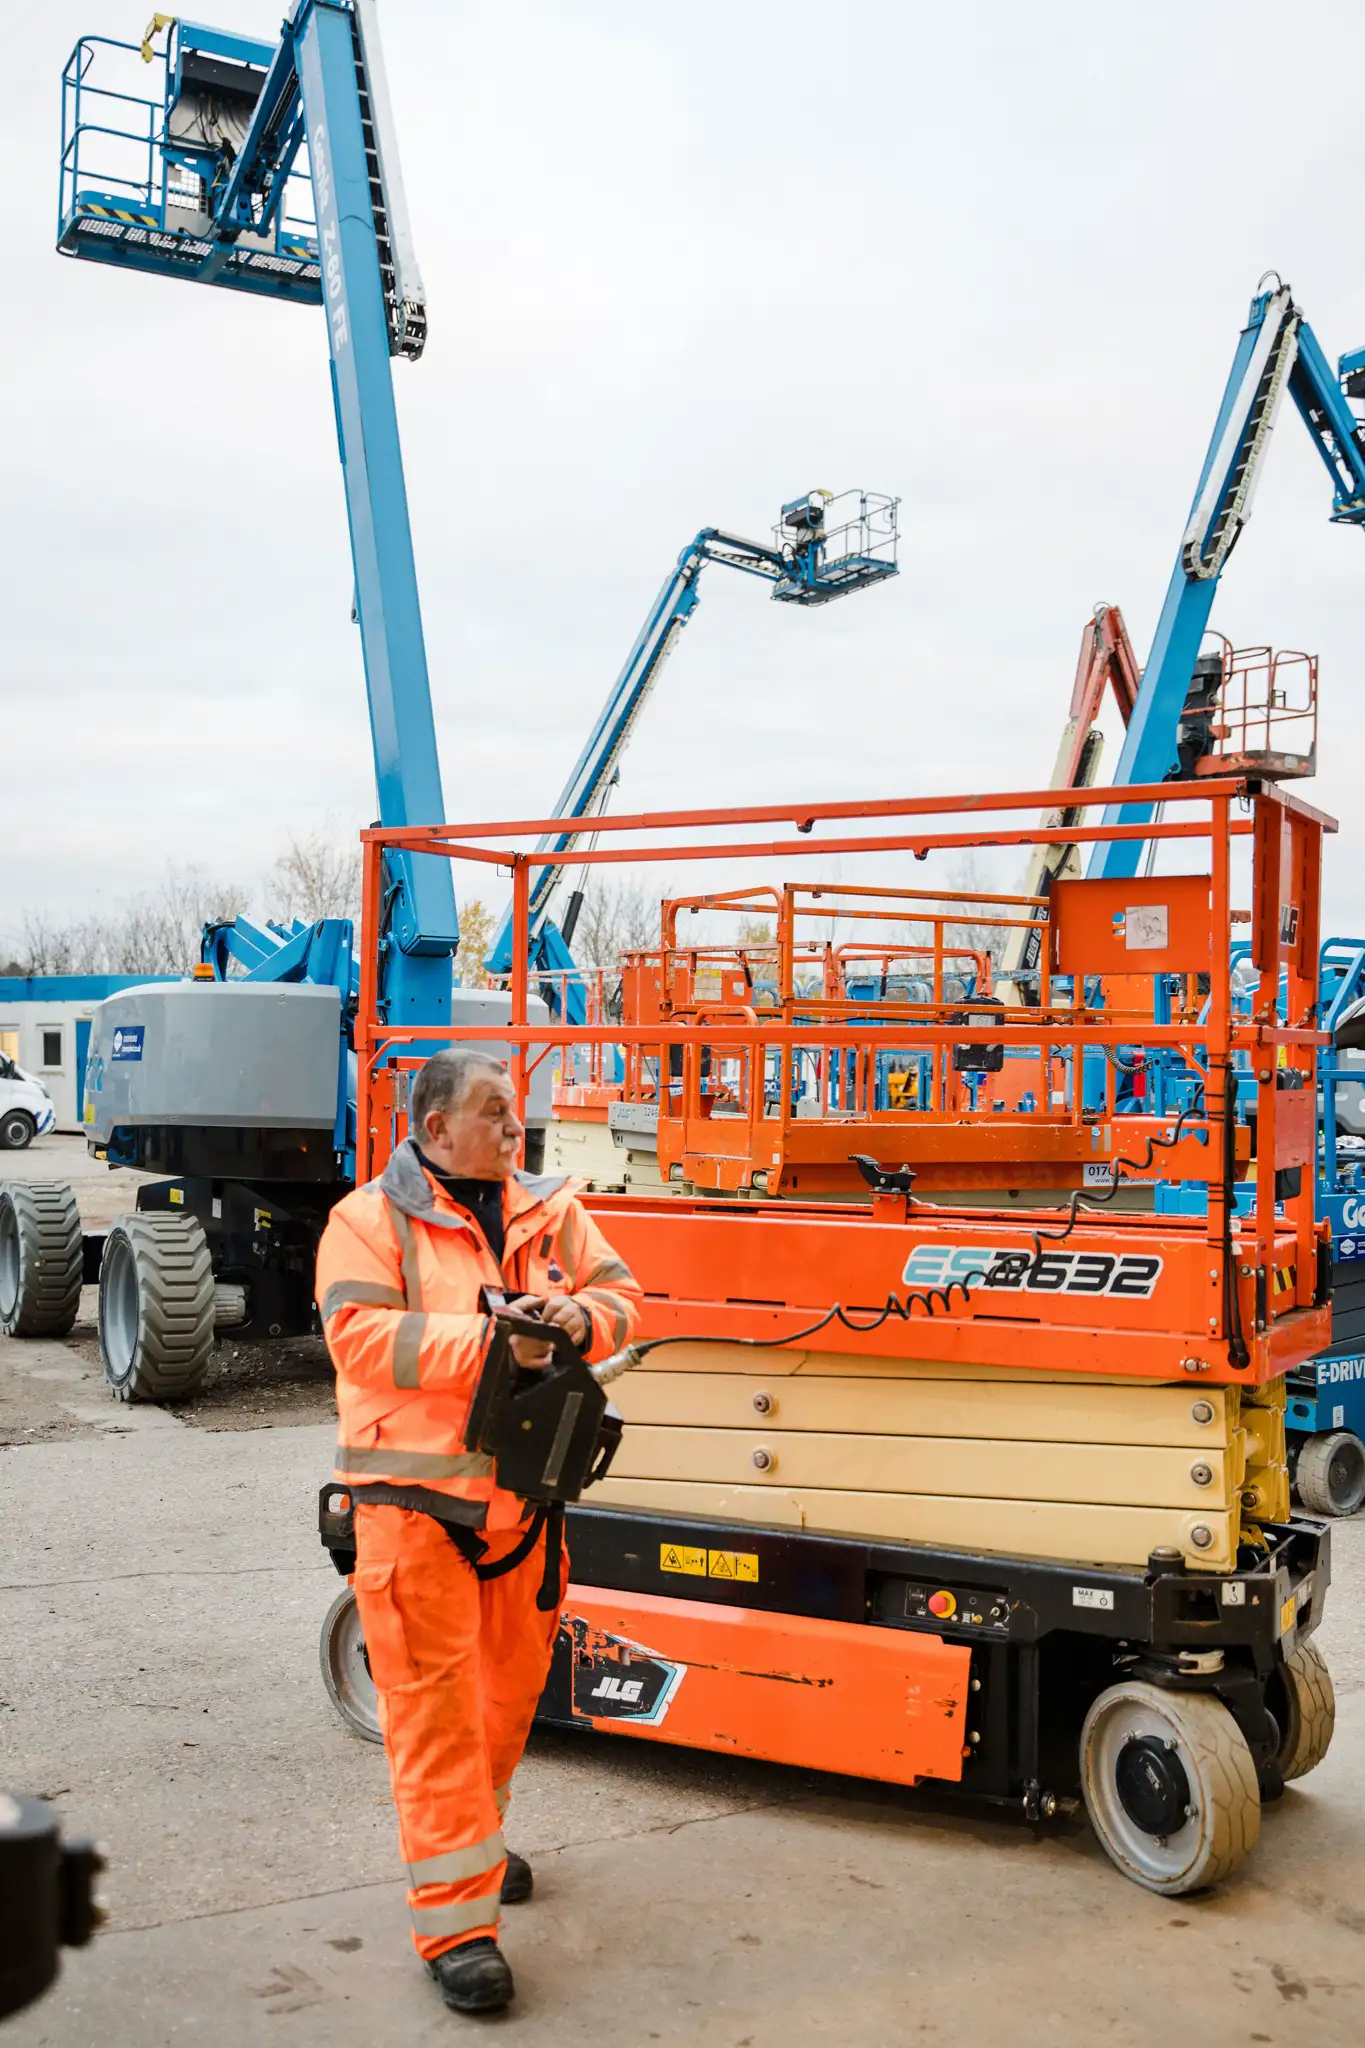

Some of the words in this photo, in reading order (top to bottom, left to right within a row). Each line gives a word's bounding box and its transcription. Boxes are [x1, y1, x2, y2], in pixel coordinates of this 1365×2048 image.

[332, 303, 348, 351] FE
[904, 1246, 1161, 1297] ES2632
[591, 1676, 643, 1702] JLG
